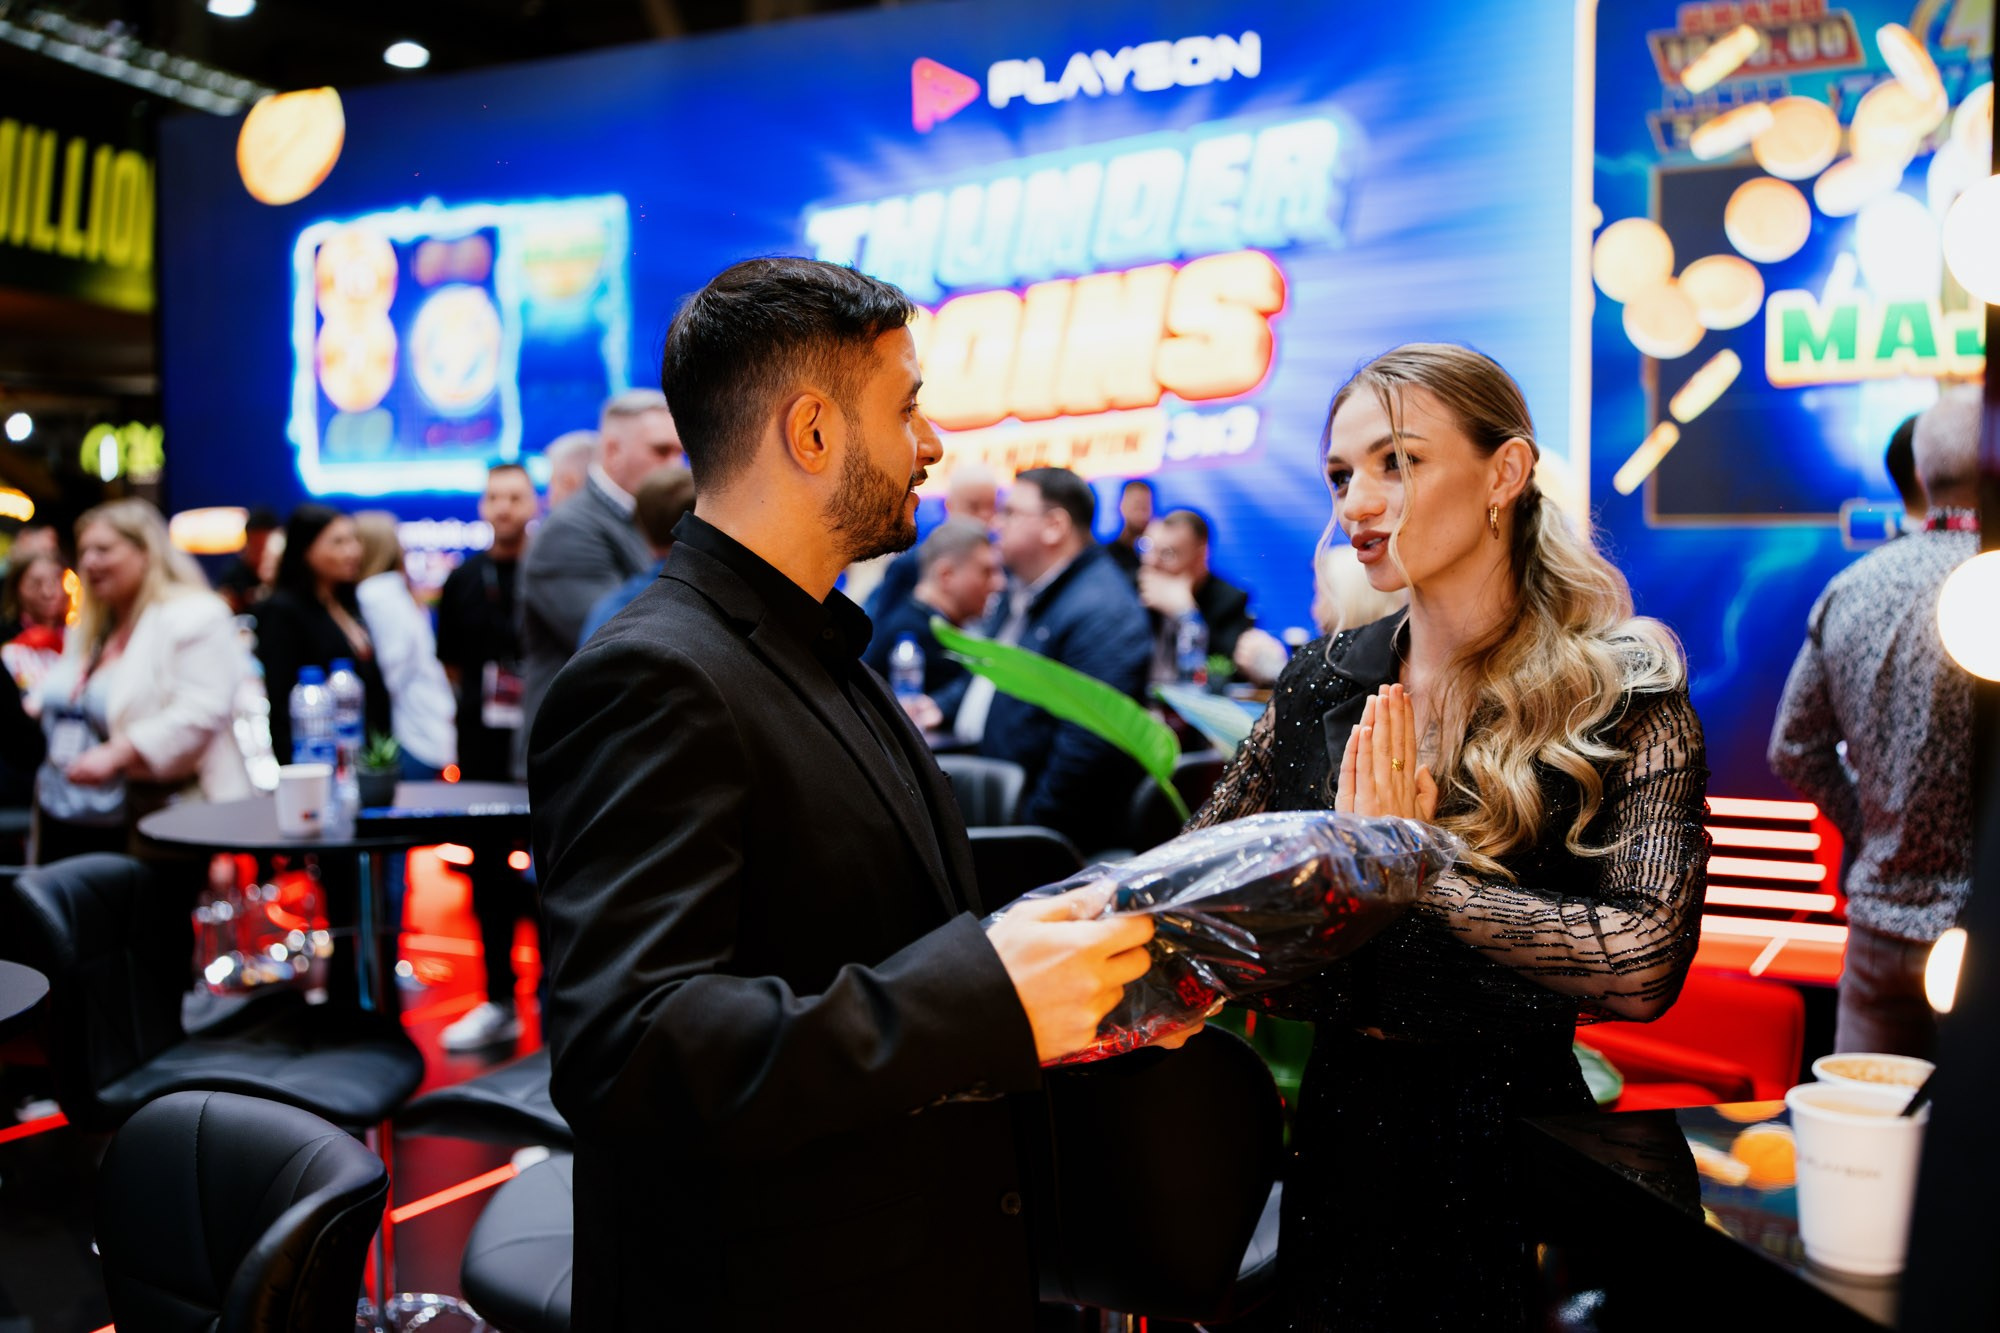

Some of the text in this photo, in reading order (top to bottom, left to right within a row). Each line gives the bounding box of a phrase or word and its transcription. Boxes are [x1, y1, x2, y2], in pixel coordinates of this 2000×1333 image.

[987, 30, 1262, 109] PLAYSON
[806, 115, 1340, 302] THUNDER
[915, 250, 1284, 432] OINS
